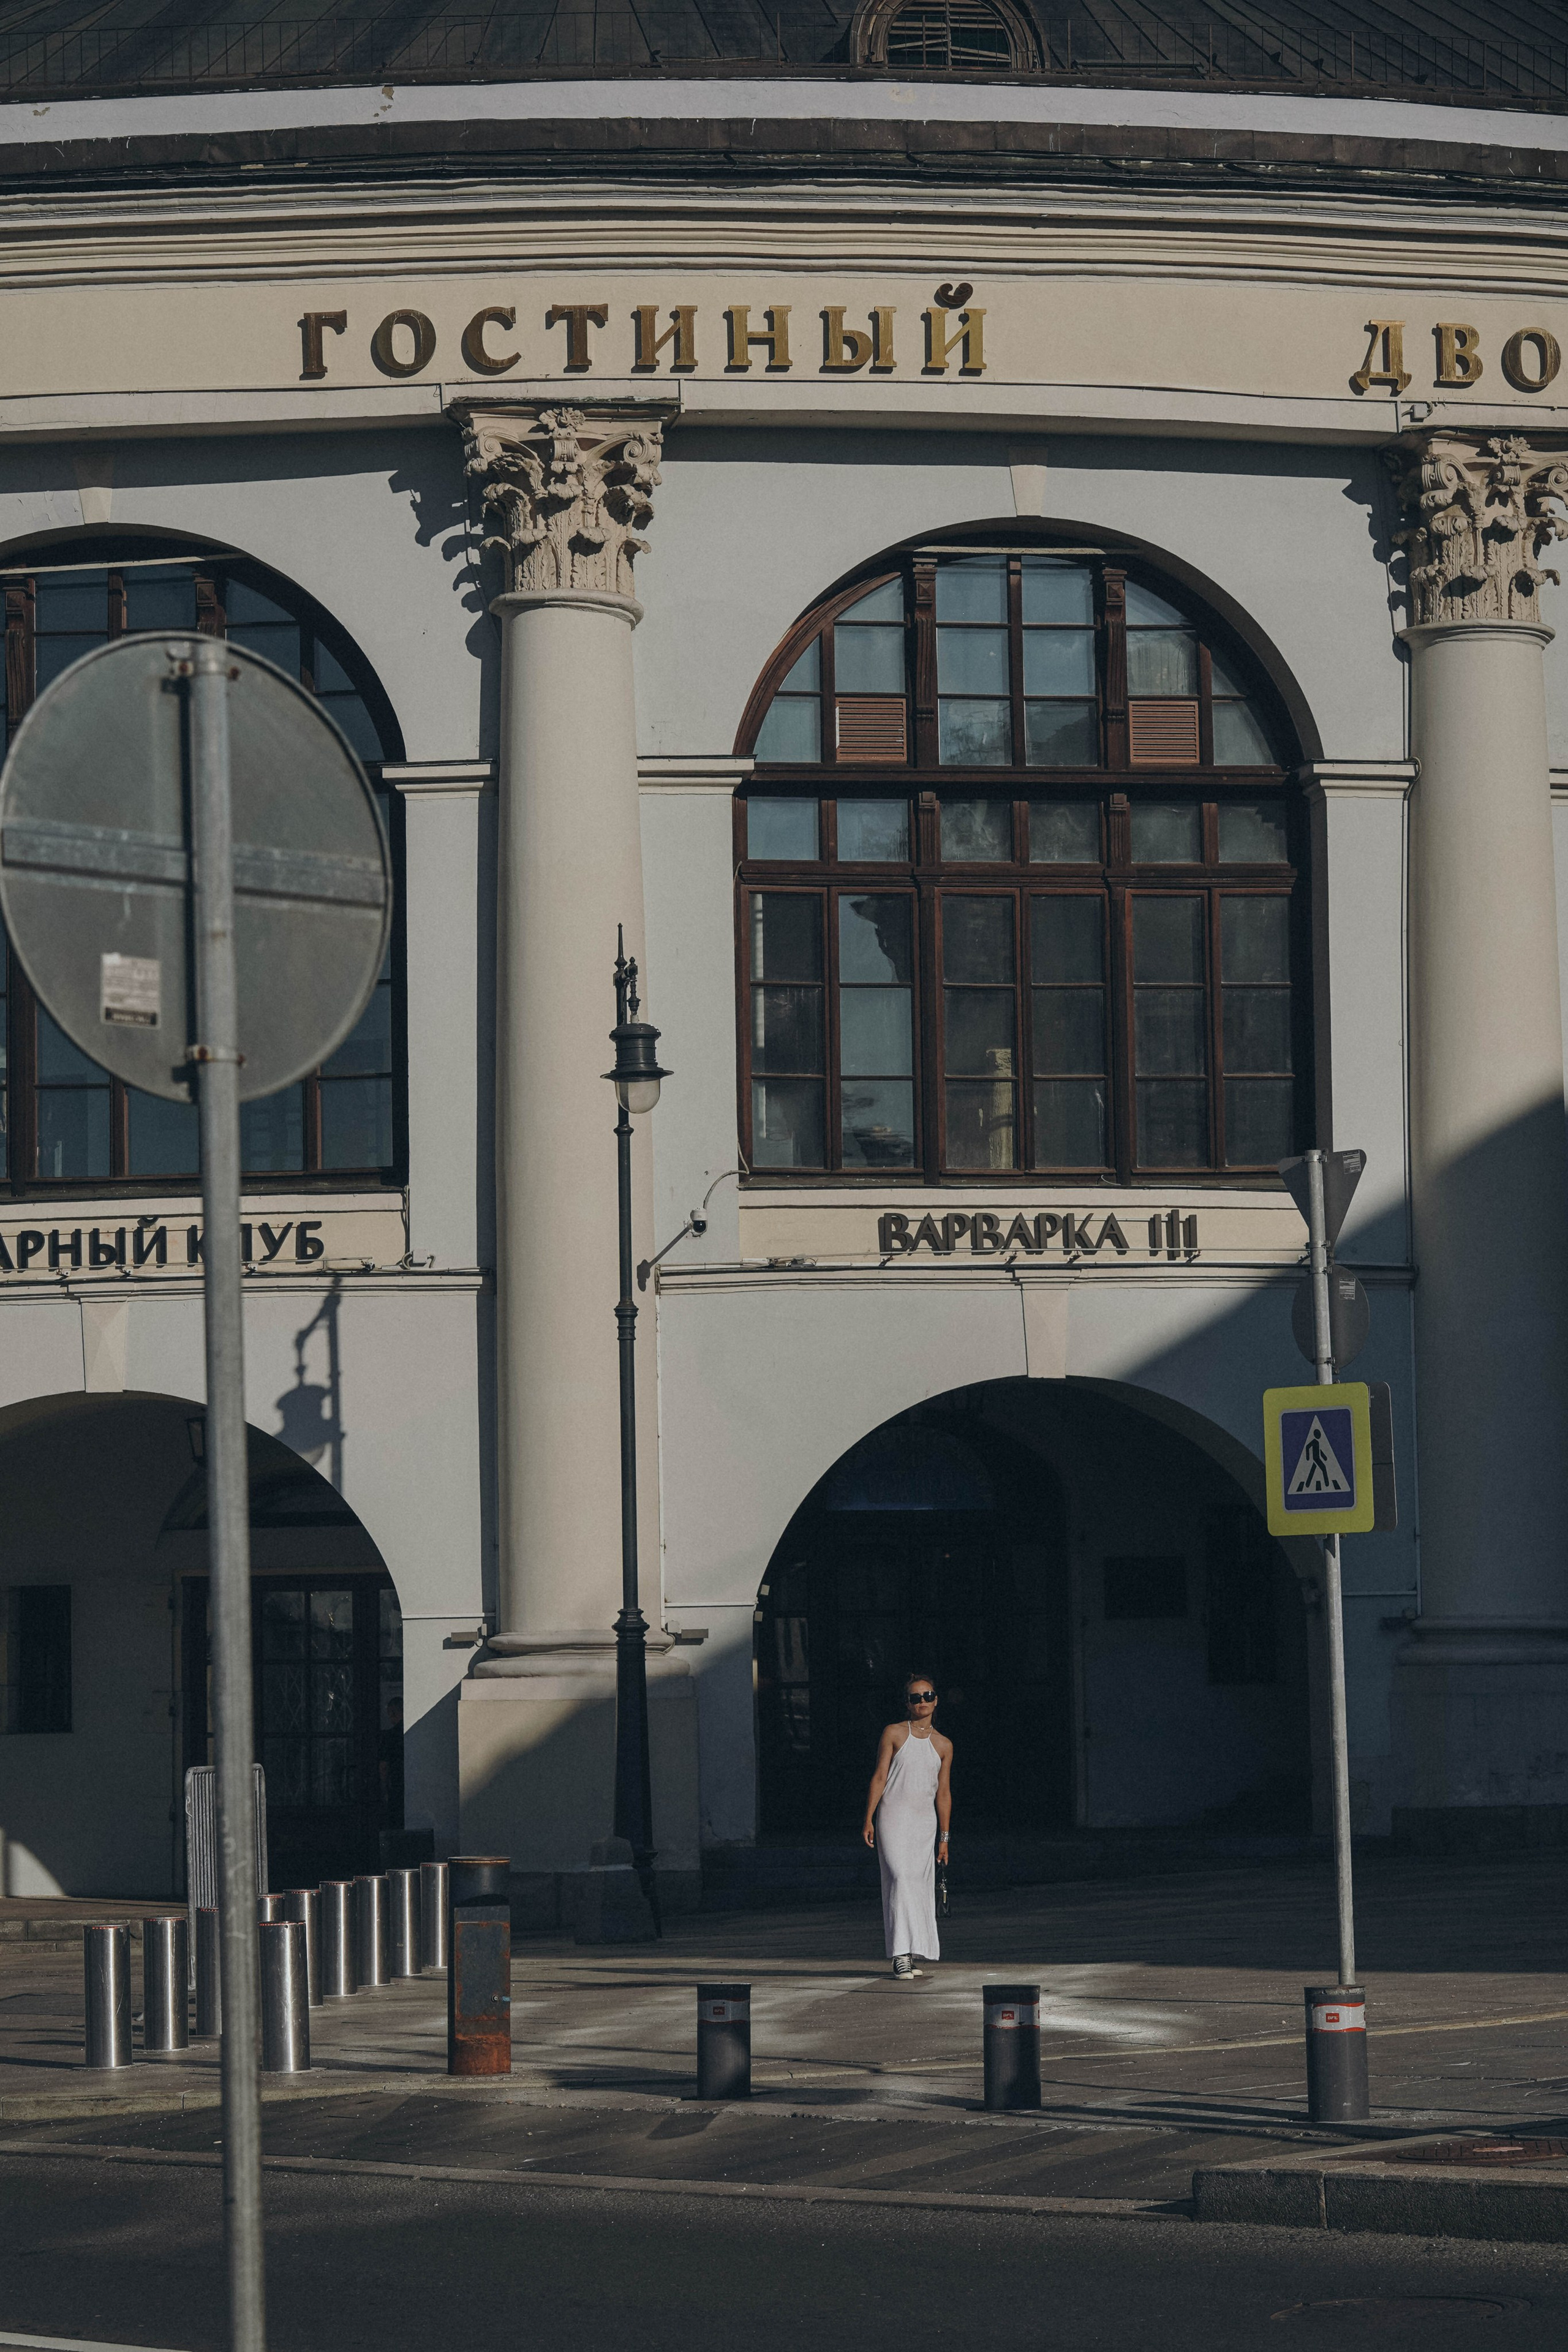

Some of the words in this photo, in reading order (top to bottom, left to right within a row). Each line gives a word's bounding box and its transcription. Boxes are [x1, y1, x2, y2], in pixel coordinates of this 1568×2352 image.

[302, 282, 987, 375] ГОСТИНЫЙ
[1352, 320, 1561, 392] ДВО
[880, 1212, 1130, 1254] ВАРВАРКА
